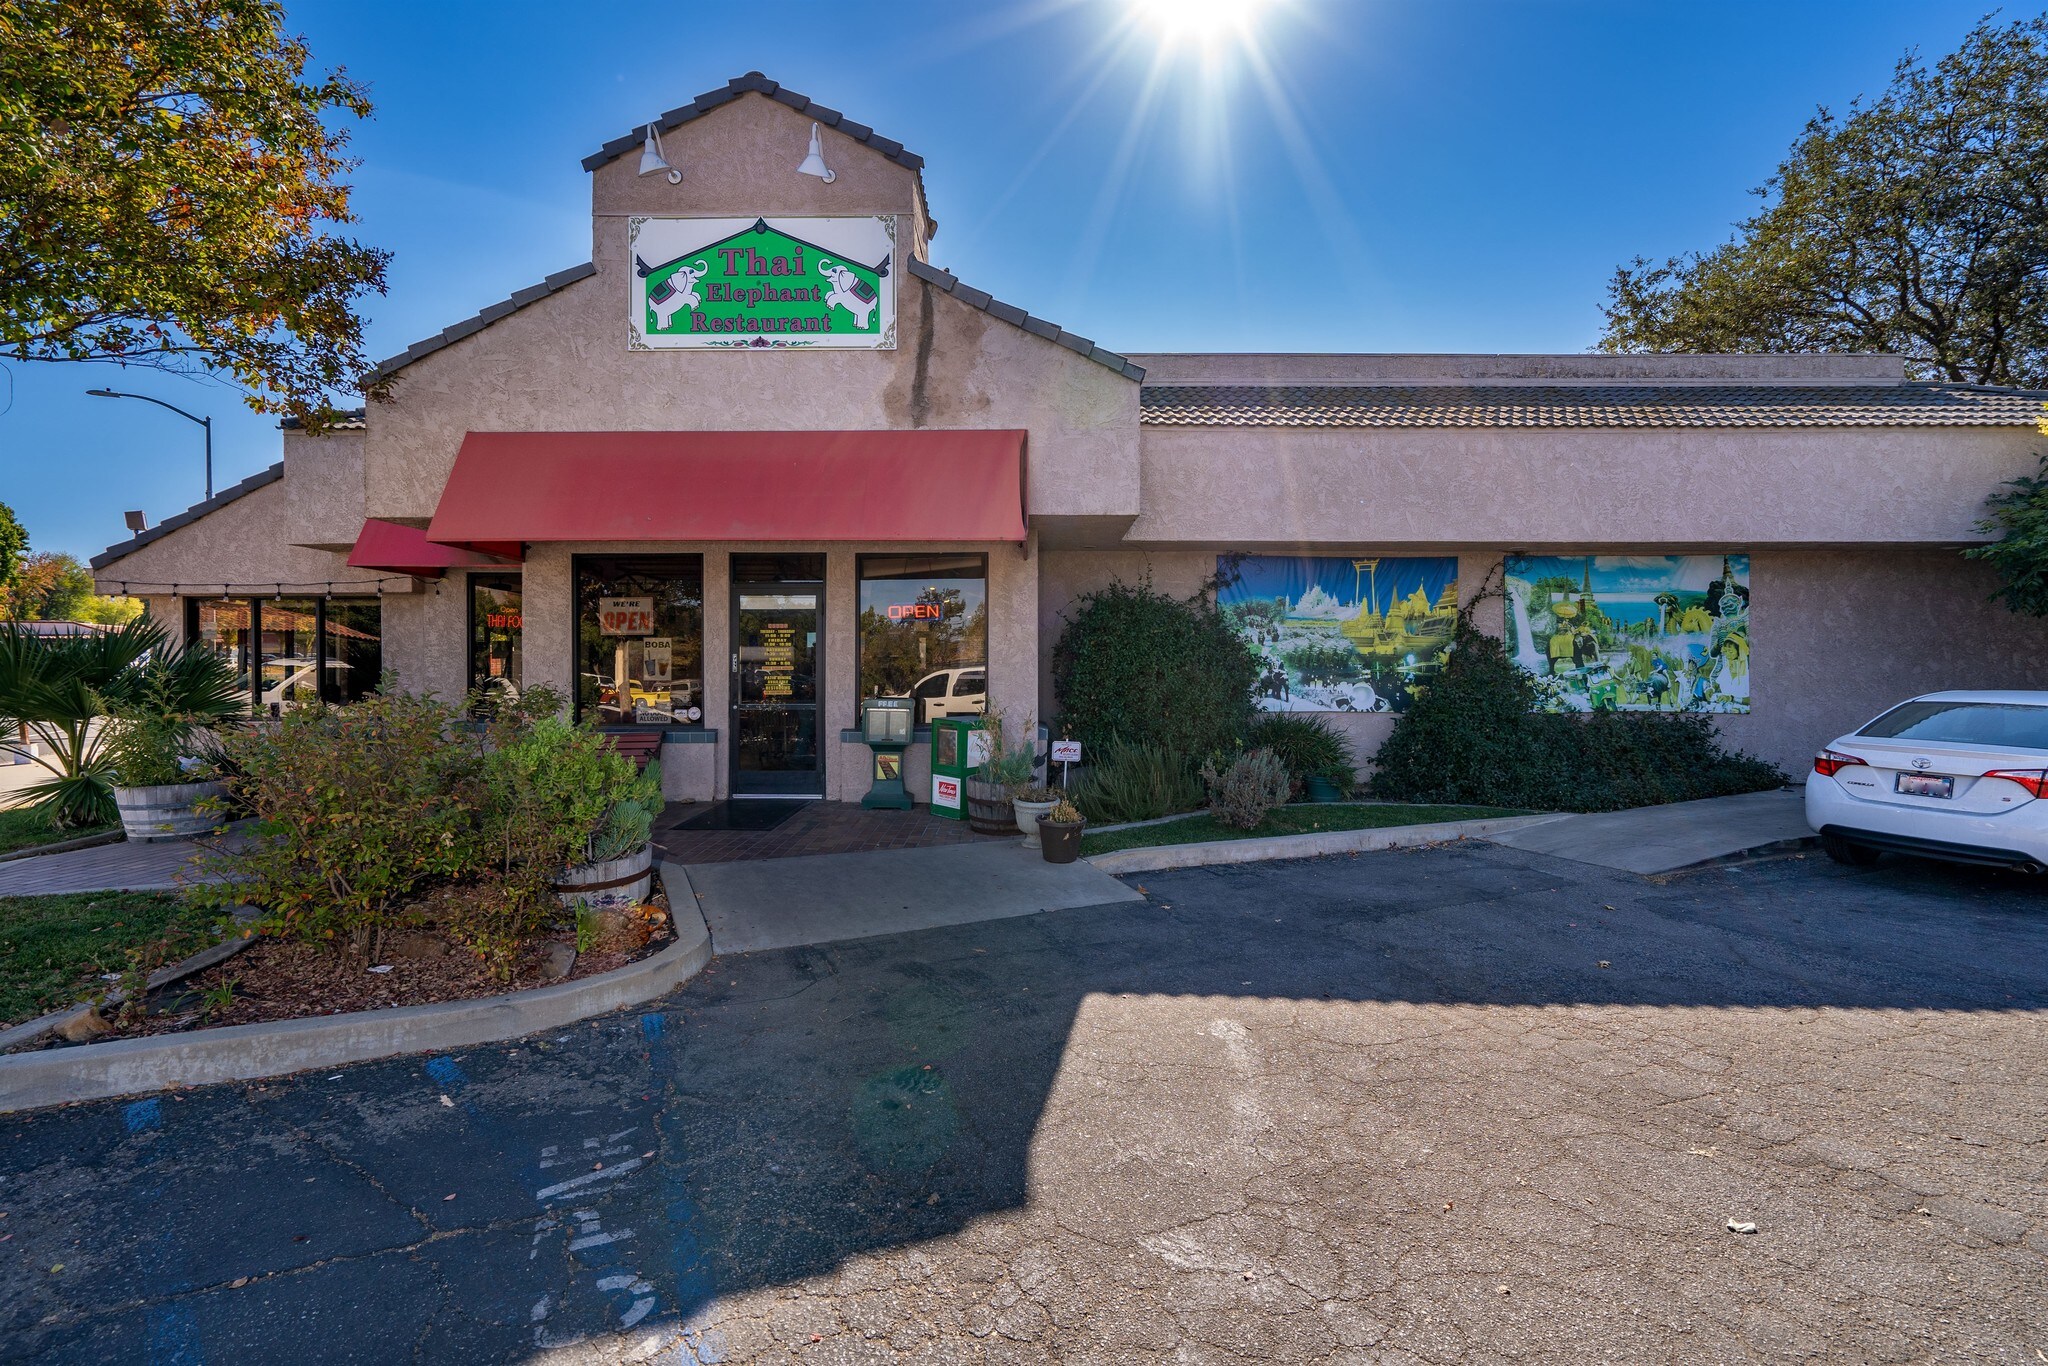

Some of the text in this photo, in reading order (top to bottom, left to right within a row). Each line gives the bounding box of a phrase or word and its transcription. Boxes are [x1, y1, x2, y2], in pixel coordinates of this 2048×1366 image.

[718, 246, 806, 276] Thai
[706, 283, 821, 308] Elephant
[690, 312, 832, 332] Restaurant
[500, 605, 519, 614] Open
[613, 600, 640, 608] WE'RE
[888, 604, 940, 619] OPEN
[487, 614, 506, 628] THAI
[604, 611, 651, 631] OPEN
[645, 641, 671, 649] BOBA
